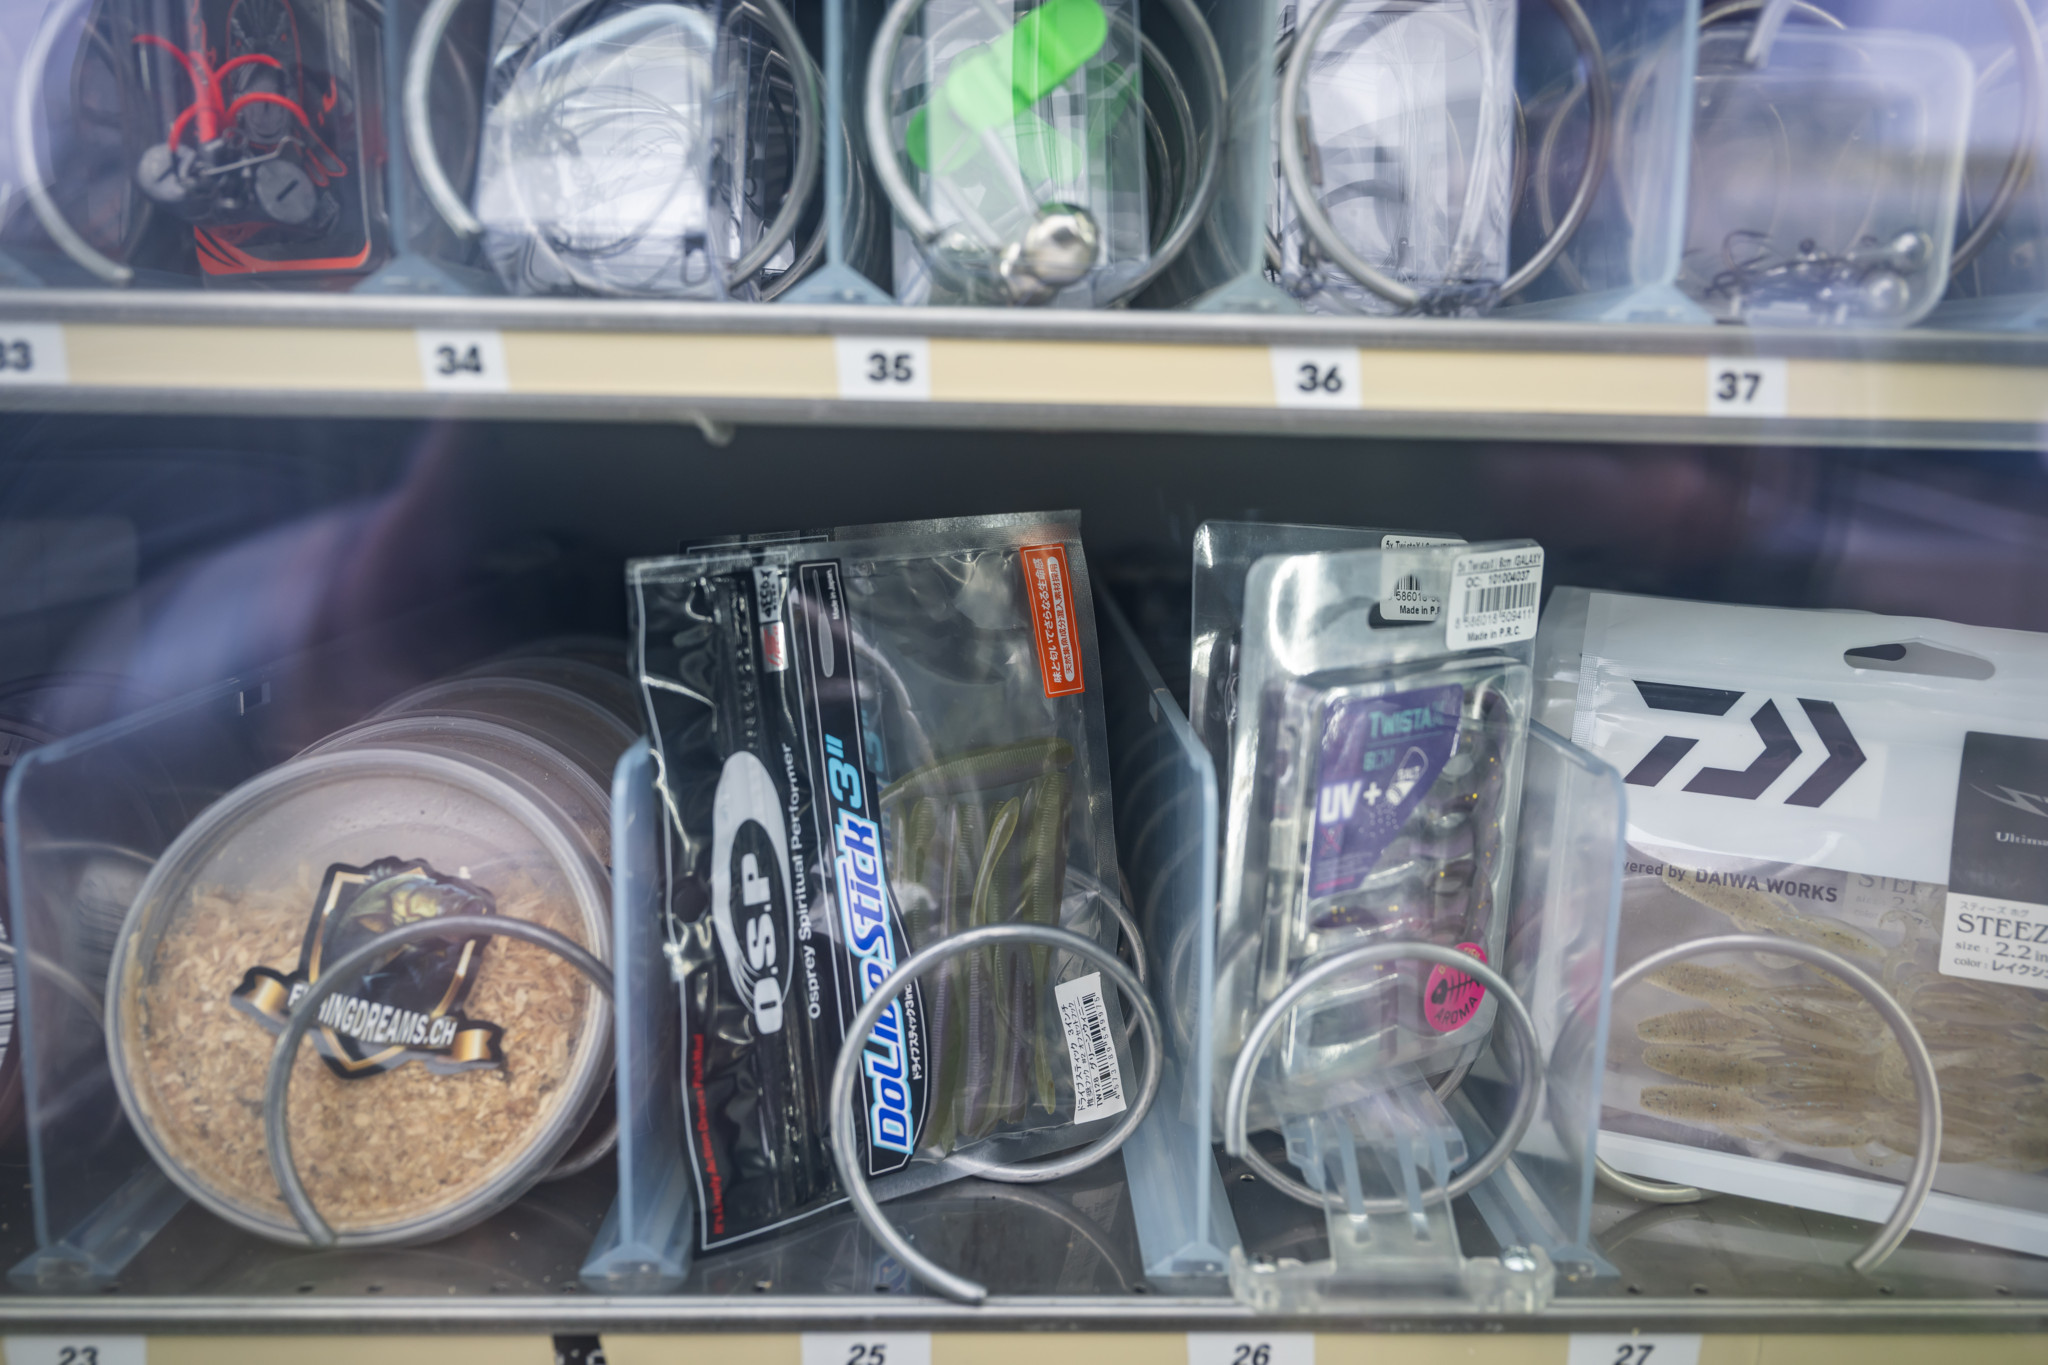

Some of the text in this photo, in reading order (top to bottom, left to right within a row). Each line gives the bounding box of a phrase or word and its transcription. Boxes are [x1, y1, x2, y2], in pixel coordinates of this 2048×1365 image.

[437, 345, 483, 376] 34
[867, 353, 914, 383] 35
[1297, 364, 1343, 393] 36
[1716, 373, 1761, 402] 37
[1033, 557, 1062, 684] 味と匂いでさらなる生命感
[1400, 605, 1419, 615] Made
[1421, 605, 1428, 615] in
[1467, 630, 1489, 642] Made
[1490, 628, 1498, 639] in
[1319, 780, 1362, 825] UV
[782, 743, 821, 1019] Osprey Spiritual Performer
[1668, 864, 1686, 882] by
[1695, 868, 1760, 891] DAIWA
[1766, 877, 1838, 903] WORKS
[1957, 912, 2048, 945] STEEZ
[1954, 957, 1981, 969] color
[1995, 941, 2032, 960] 2.2
[288, 982, 458, 1046] FINGDREAMS.CH
[1434, 996, 1479, 1025] AROMA
[58, 1346, 98, 1365] 23
[846, 1343, 888, 1365] 25
[1232, 1343, 1271, 1365] 26
[1613, 1343, 1655, 1365] 27
